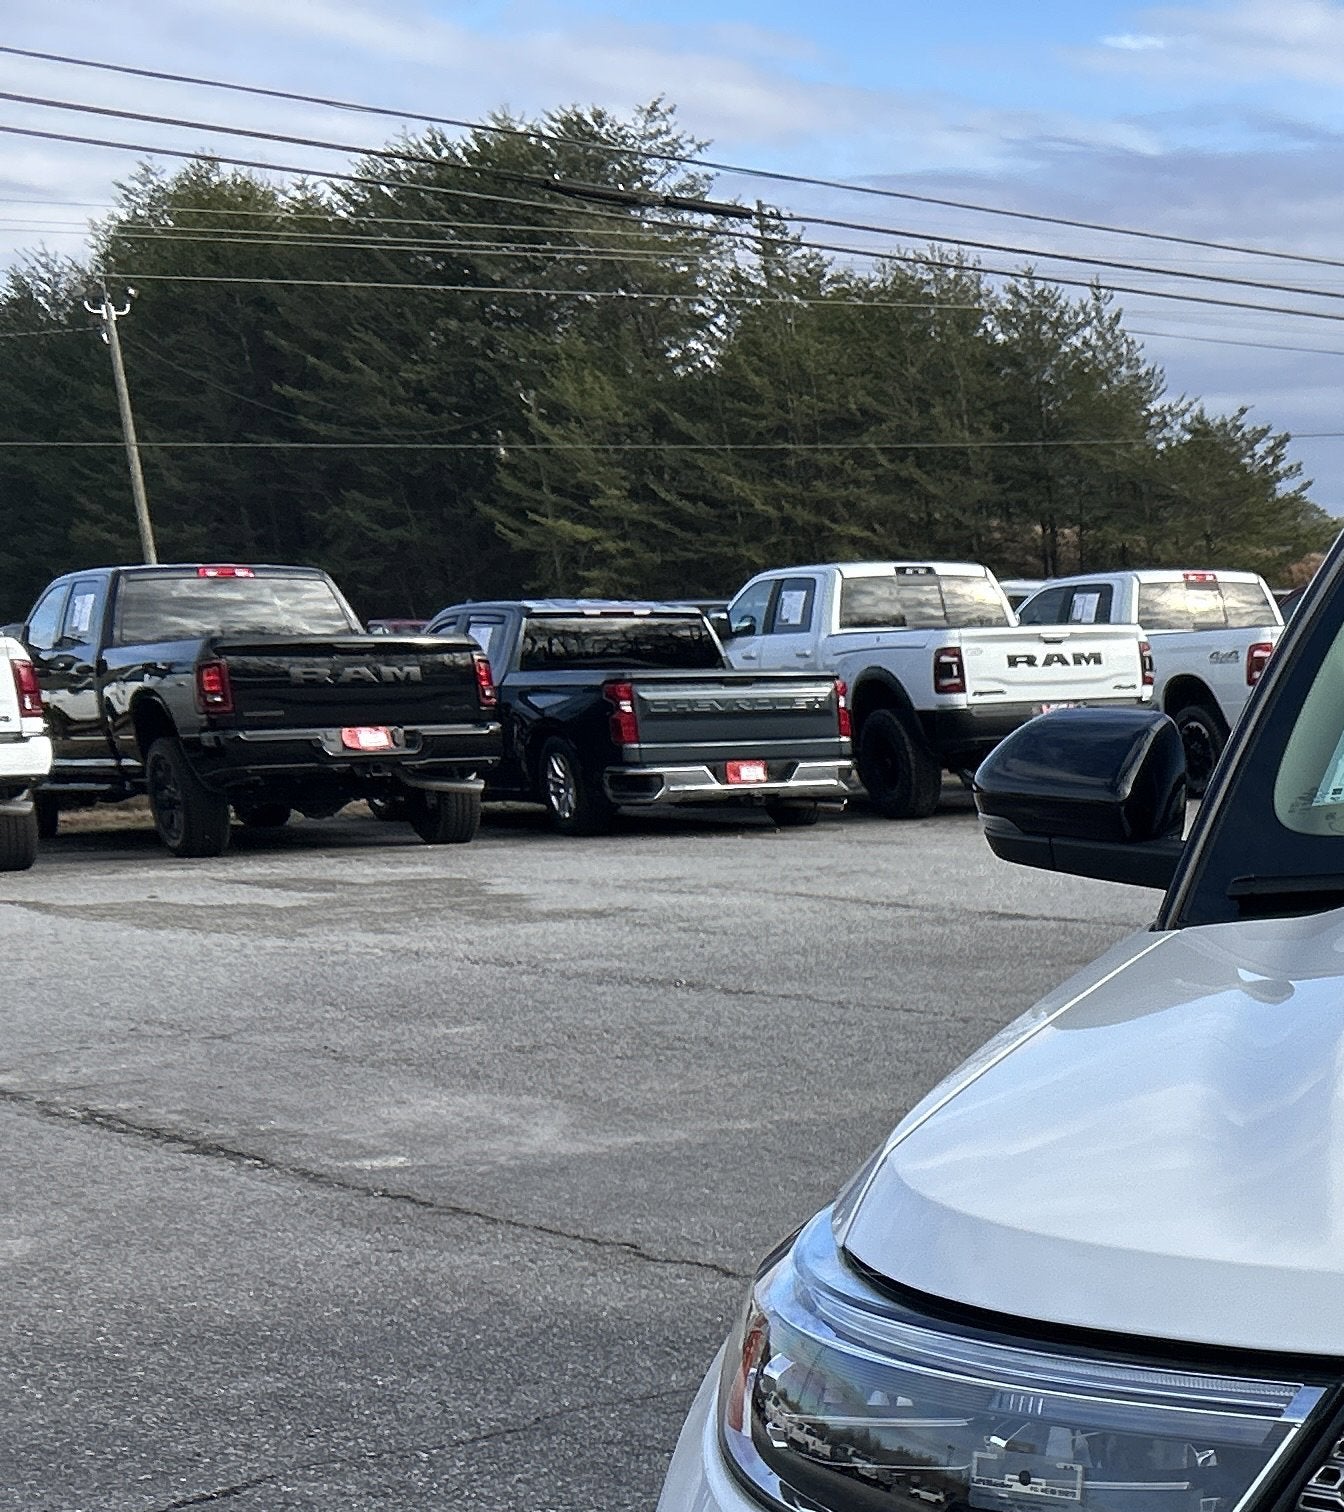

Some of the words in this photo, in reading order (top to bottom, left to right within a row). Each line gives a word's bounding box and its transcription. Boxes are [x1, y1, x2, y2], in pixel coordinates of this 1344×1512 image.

[1006, 652, 1103, 668] RAM
[288, 665, 424, 684] RAM
[648, 696, 826, 713] CHEVROLET
